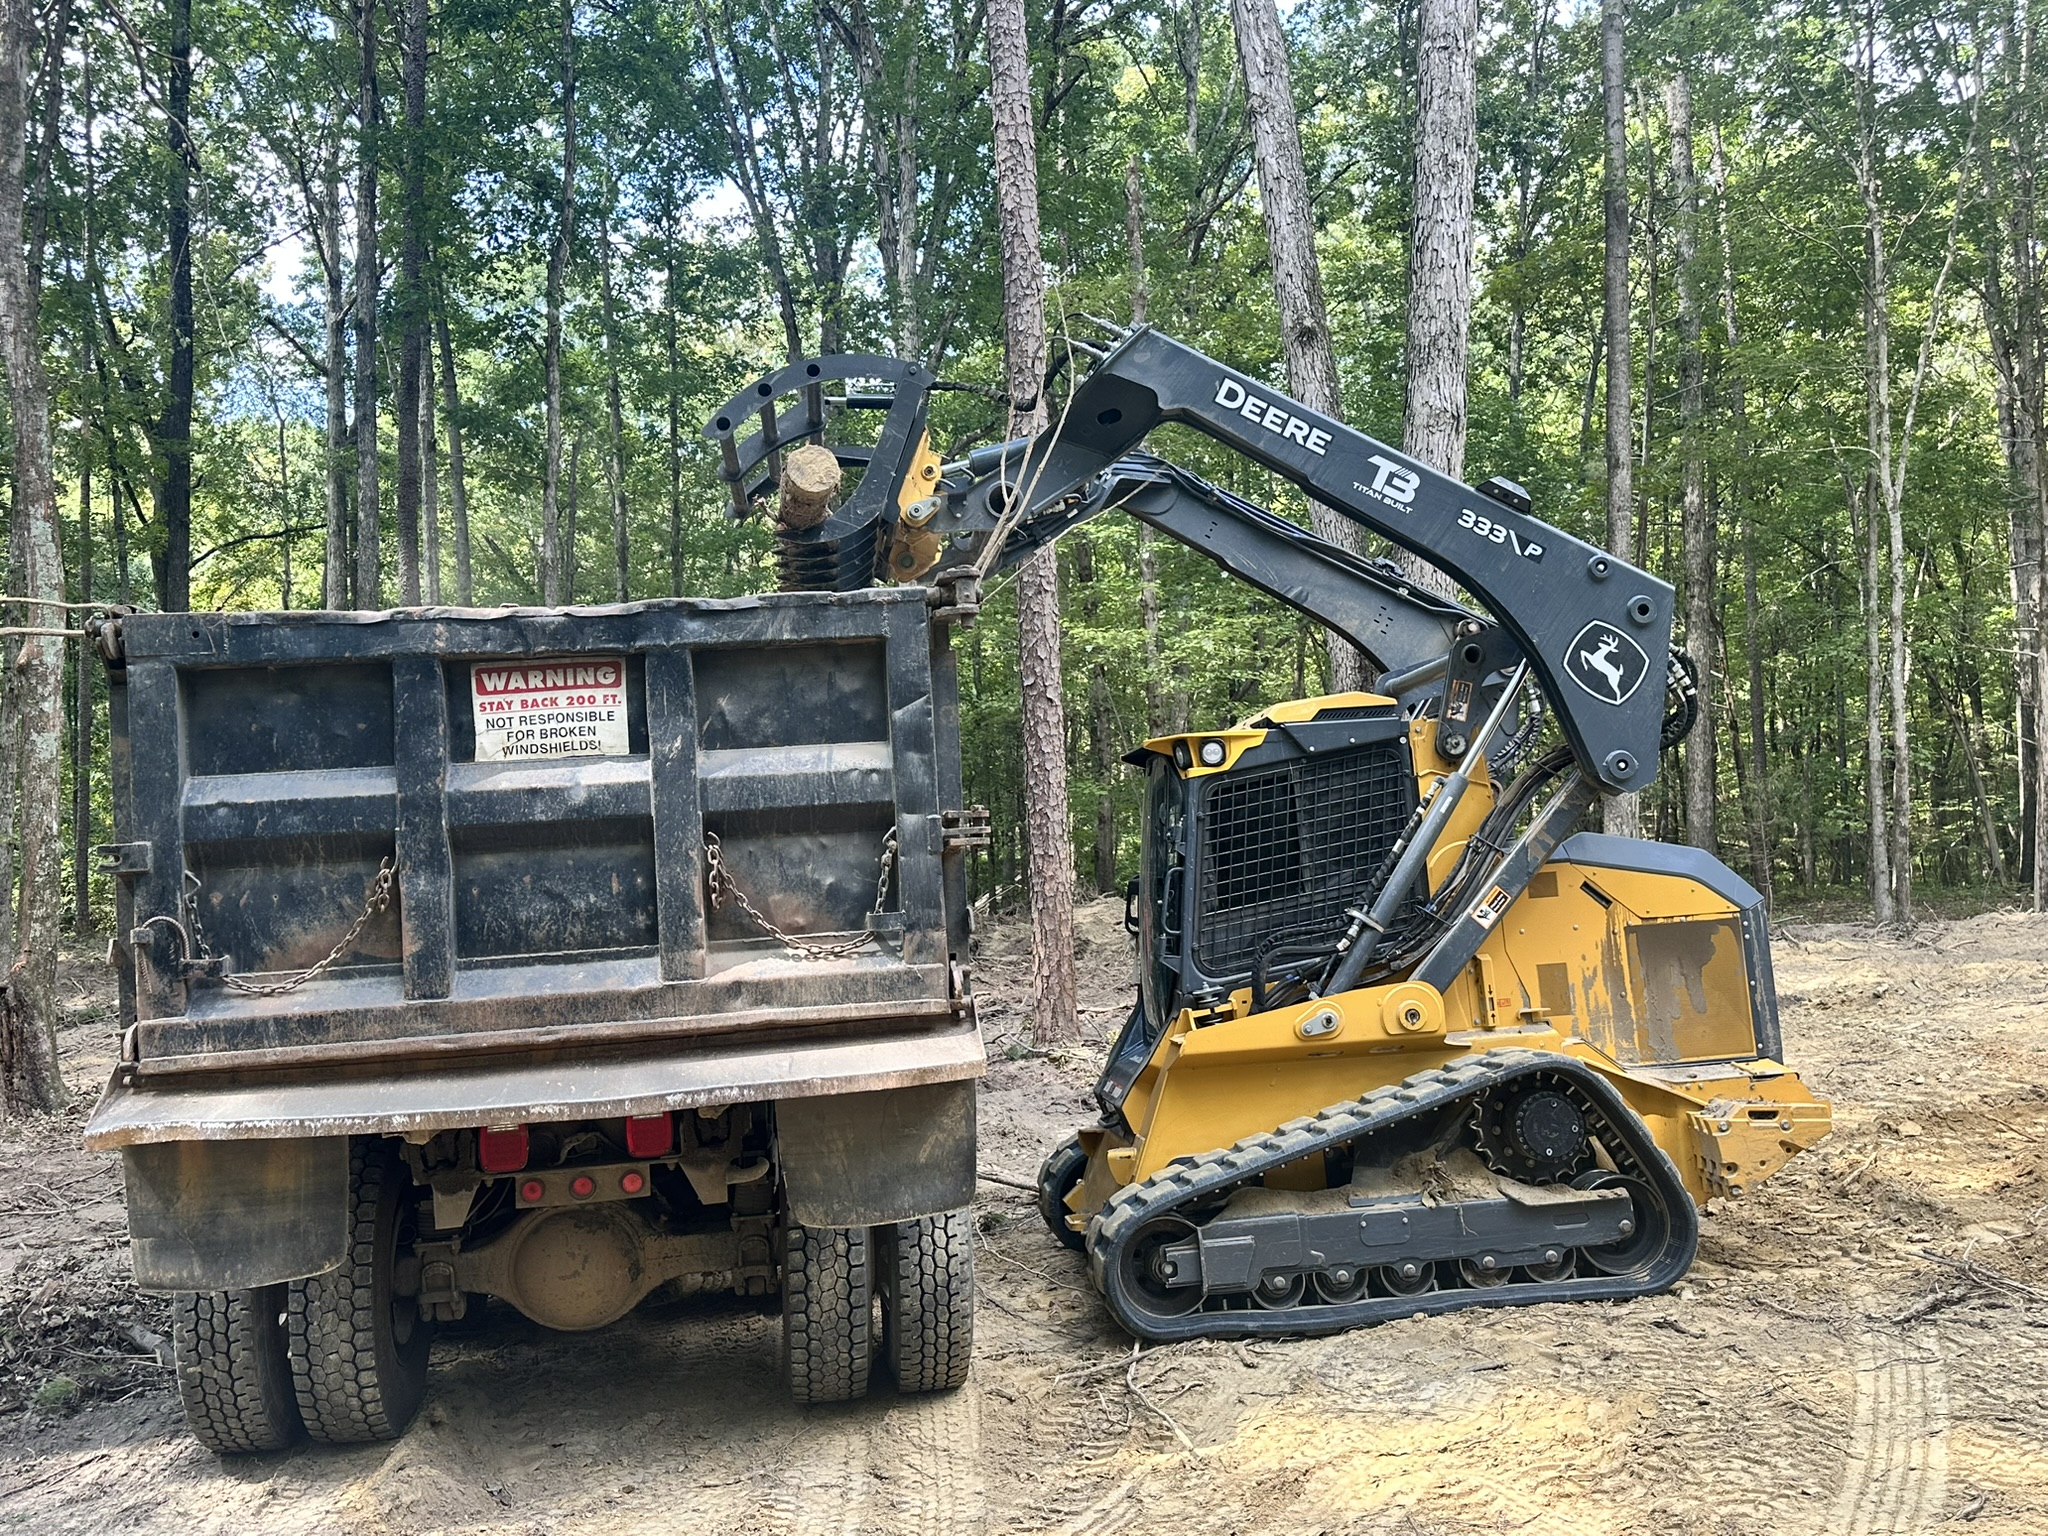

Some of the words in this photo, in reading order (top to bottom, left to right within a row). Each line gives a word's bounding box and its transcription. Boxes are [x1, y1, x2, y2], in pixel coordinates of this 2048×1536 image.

[1214, 377, 1333, 456] DEERE
[1352, 481, 1383, 501] TITAN
[1382, 496, 1414, 514] BUILT
[480, 666, 617, 692] WARNING
[479, 700, 514, 713] STAY
[520, 696, 559, 710] BACK
[566, 694, 597, 706] 200
[603, 694, 622, 705] FT.
[486, 716, 515, 729] NOT
[519, 710, 616, 727] RESPONSIBLE
[507, 729, 535, 742] FOR
[540, 725, 597, 740] BROKEN
[502, 739, 602, 758] WINDSHIELDS!
